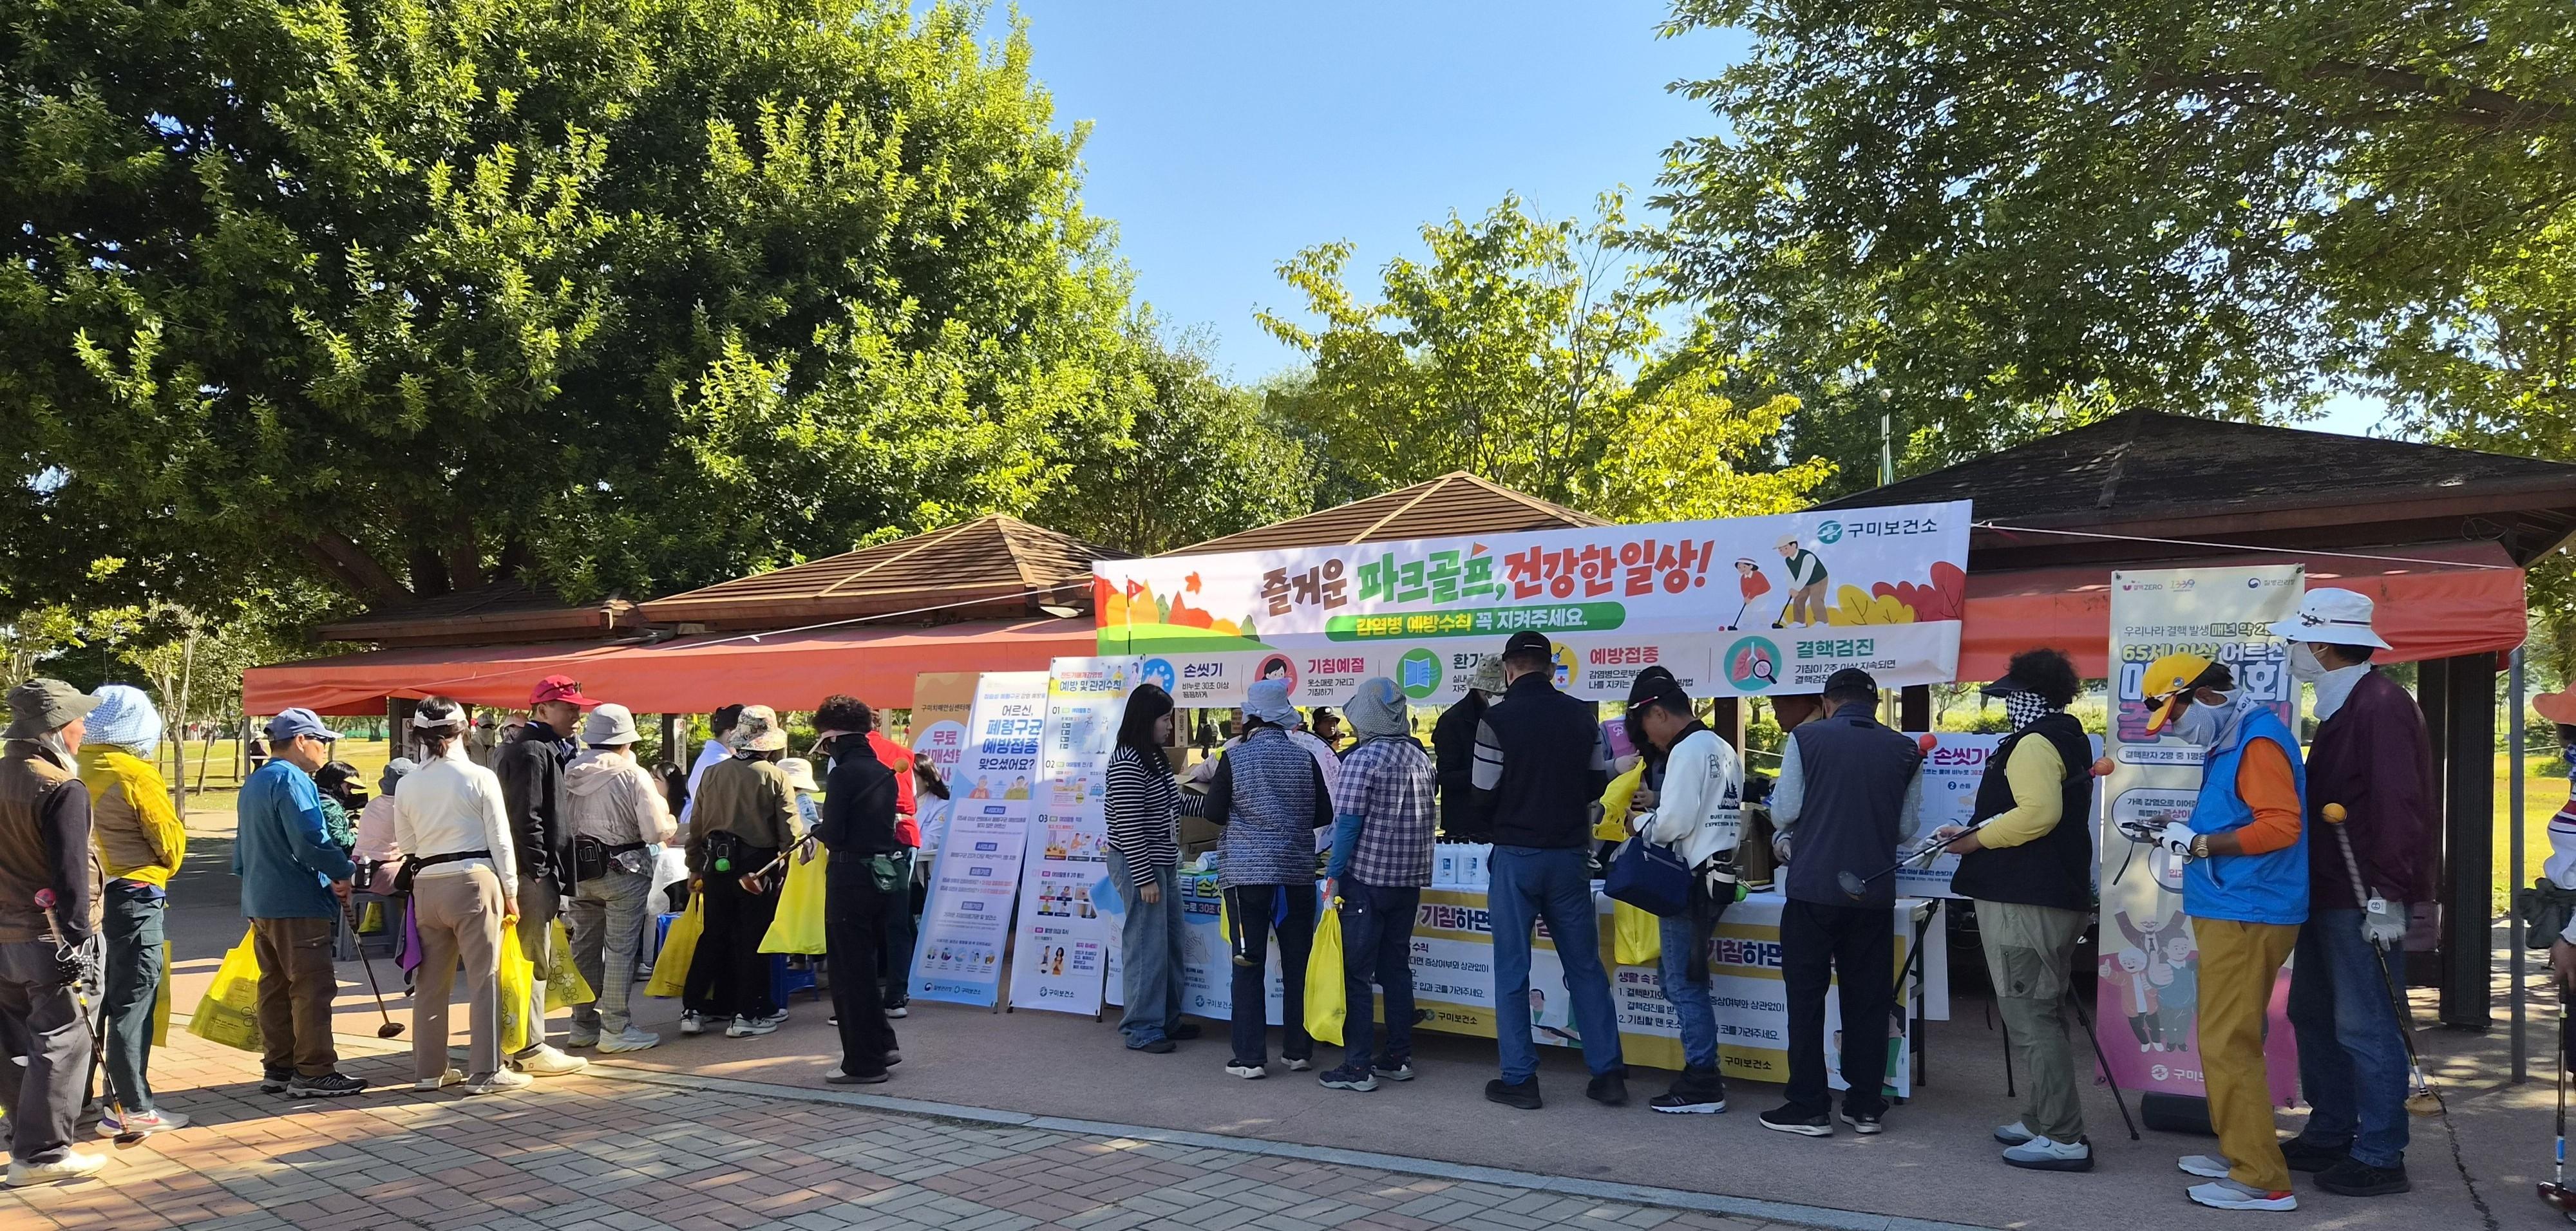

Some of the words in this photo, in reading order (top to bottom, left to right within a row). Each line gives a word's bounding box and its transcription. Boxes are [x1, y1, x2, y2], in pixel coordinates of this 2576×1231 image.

[1848, 519, 1937, 538] 구미보건소
[1260, 558, 1347, 617] 즐거운
[1357, 550, 1506, 605] 파크골프,
[1504, 544, 1617, 599] 건강한
[1620, 539, 1715, 597] 일상!
[2170, 579, 2195, 588] 1339
[1356, 617, 1402, 635] 감염병
[1408, 613, 1472, 634] 예방수칙
[1475, 611, 1492, 630] 꼭
[1497, 608, 1587, 629] 지켜주세요.
[2125, 626, 2164, 637] 우리나라
[2167, 625, 2187, 636] 결핵
[2189, 625, 2209, 636] 발생
[2210, 623, 2237, 637] 매년
[2239, 623, 2253, 637] 약
[1796, 639, 1874, 658] 결핵검진
[2121, 644, 2172, 662] 65세
[2223, 643, 2287, 662] 어르신
[1589, 646, 1659, 665] 예방접종
[1184, 662, 1223, 678] 손씻기
[1307, 657, 1364, 675] 기침예절
[1795, 664, 1822, 673] 기침이
[1824, 663, 1837, 672] 2주
[1860, 660, 1895, 670] 지속되면
[1060, 681, 1078, 691] 예방
[1080, 680, 1088, 691] 및
[1090, 680, 1122, 691] 관리수칙
[1307, 679, 1334, 688] 옷소매로
[1335, 679, 1355, 687] 가리고
[1453, 675, 1467, 683] 실내
[1589, 681, 1604, 689] 나를
[1606, 680, 1630, 689] 지키는
[1182, 690, 1208, 699] 꼼꼼하게
[1307, 688, 1334, 696] 기침하기
[1002, 705, 1033, 716] 어르신,
[986, 719, 1043, 735] 폐렴구균
[933, 731, 957, 745] 무료
[982, 738, 1038, 754] 예방접종
[1934, 747, 1989, 766] 손씻기
[2186, 752, 2206, 760] 1명은
[978, 758, 1035, 770] 맞으셨어요?
[2127, 798, 2143, 806] 가족
[1039, 814, 1048, 823] 03
[1183, 903, 1197, 912] 누로
[1199, 903, 1215, 914] 30초
[1421, 905, 1492, 932] 기침하면
[1412, 942, 1429, 953] 수칙
[1707, 939, 1783, 966] 기침하면
[1461, 961, 1489, 973] 상관없이
[1618, 972, 1639, 983] 생활
[1641, 973, 1651, 984] 속
[1049, 989, 1074, 998] 구미보건소
[1419, 982, 1433, 992] 입과
[1435, 984, 1448, 993] 코를
[1450, 986, 1484, 997] 가려주세요.
[1618, 988, 1625, 997] 1.
[1710, 996, 1748, 1009] 증상여부와
[1751, 999, 1785, 1012] 상관없이
[1438, 1012, 1477, 1025] 구미보건소
[1618, 1014, 1626, 1024] 2.
[1627, 1015, 1653, 1026] 기침할
[1720, 1024, 1736, 1035] 코를
[1738, 1026, 1780, 1040] 가려주세요.
[1725, 1056, 1772, 1070] 구미보건소
